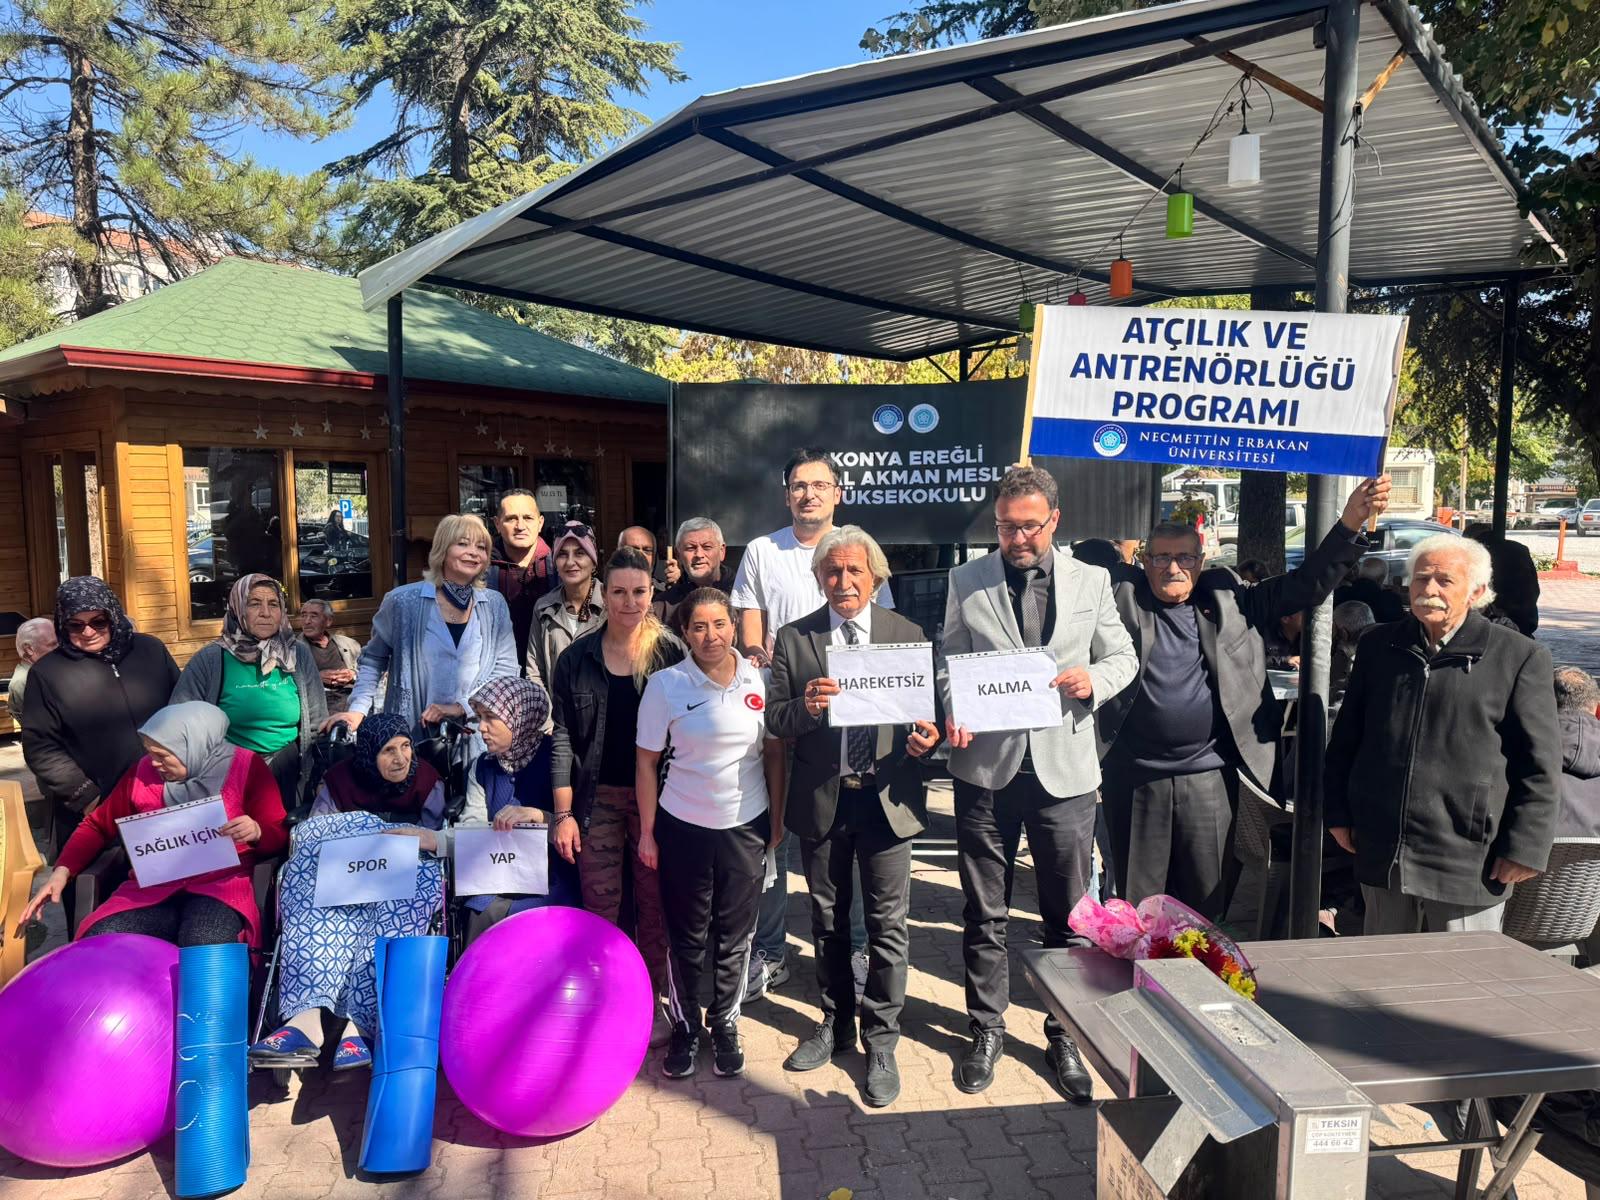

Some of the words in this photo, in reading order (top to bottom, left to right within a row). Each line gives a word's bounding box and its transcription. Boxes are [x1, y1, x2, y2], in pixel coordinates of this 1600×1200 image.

[1122, 316, 1249, 351] ATÇILIK
[1263, 321, 1309, 350] VE
[1070, 352, 1356, 391] ANTRENÖRLÜĞÜ
[1111, 391, 1299, 427] PROGRAMI
[1139, 430, 1231, 447] NECMETTİN
[1237, 437, 1309, 452] ERBAKAN
[830, 451, 900, 467] KONYA
[909, 444, 983, 466] EREĞLİ
[1168, 446, 1276, 465] ÜNİVERSİTESİ
[860, 469, 940, 486] AKMAN
[841, 485, 987, 506] ÜKSEKOKULU
[838, 672, 925, 690] HAREKETSİZ
[977, 679, 1033, 696] KALMA
[134, 834, 190, 857] SAĞLIK
[190, 826, 223, 845] İÇİN
[346, 857, 388, 874] SPOR
[489, 851, 517, 865] YAP
[1312, 1139, 1329, 1147] 444
